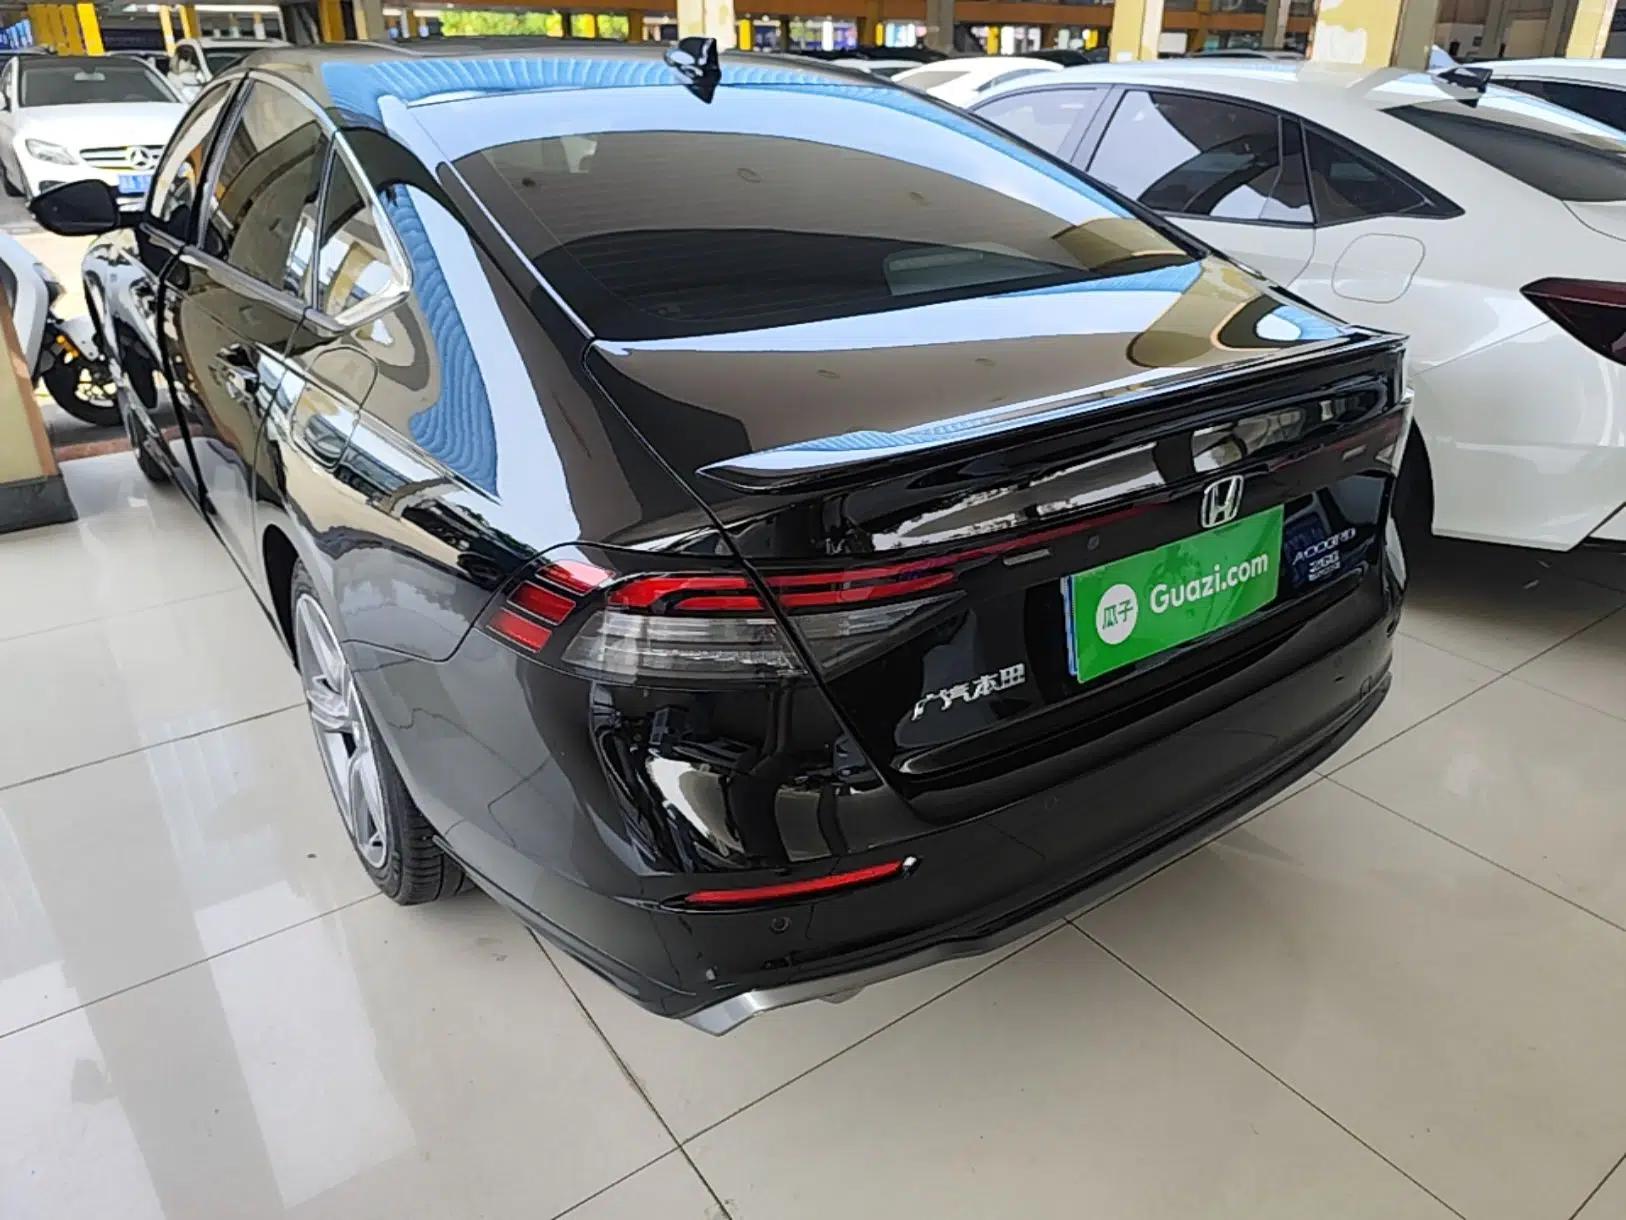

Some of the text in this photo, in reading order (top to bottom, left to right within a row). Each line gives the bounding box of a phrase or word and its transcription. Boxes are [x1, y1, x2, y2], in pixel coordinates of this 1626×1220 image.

[1292, 527, 1356, 566] ACCORD
[1150, 553, 1268, 614] Guazi.com
[1102, 599, 1134, 630] 瓜子
[911, 662, 1026, 721] 广汽本田
